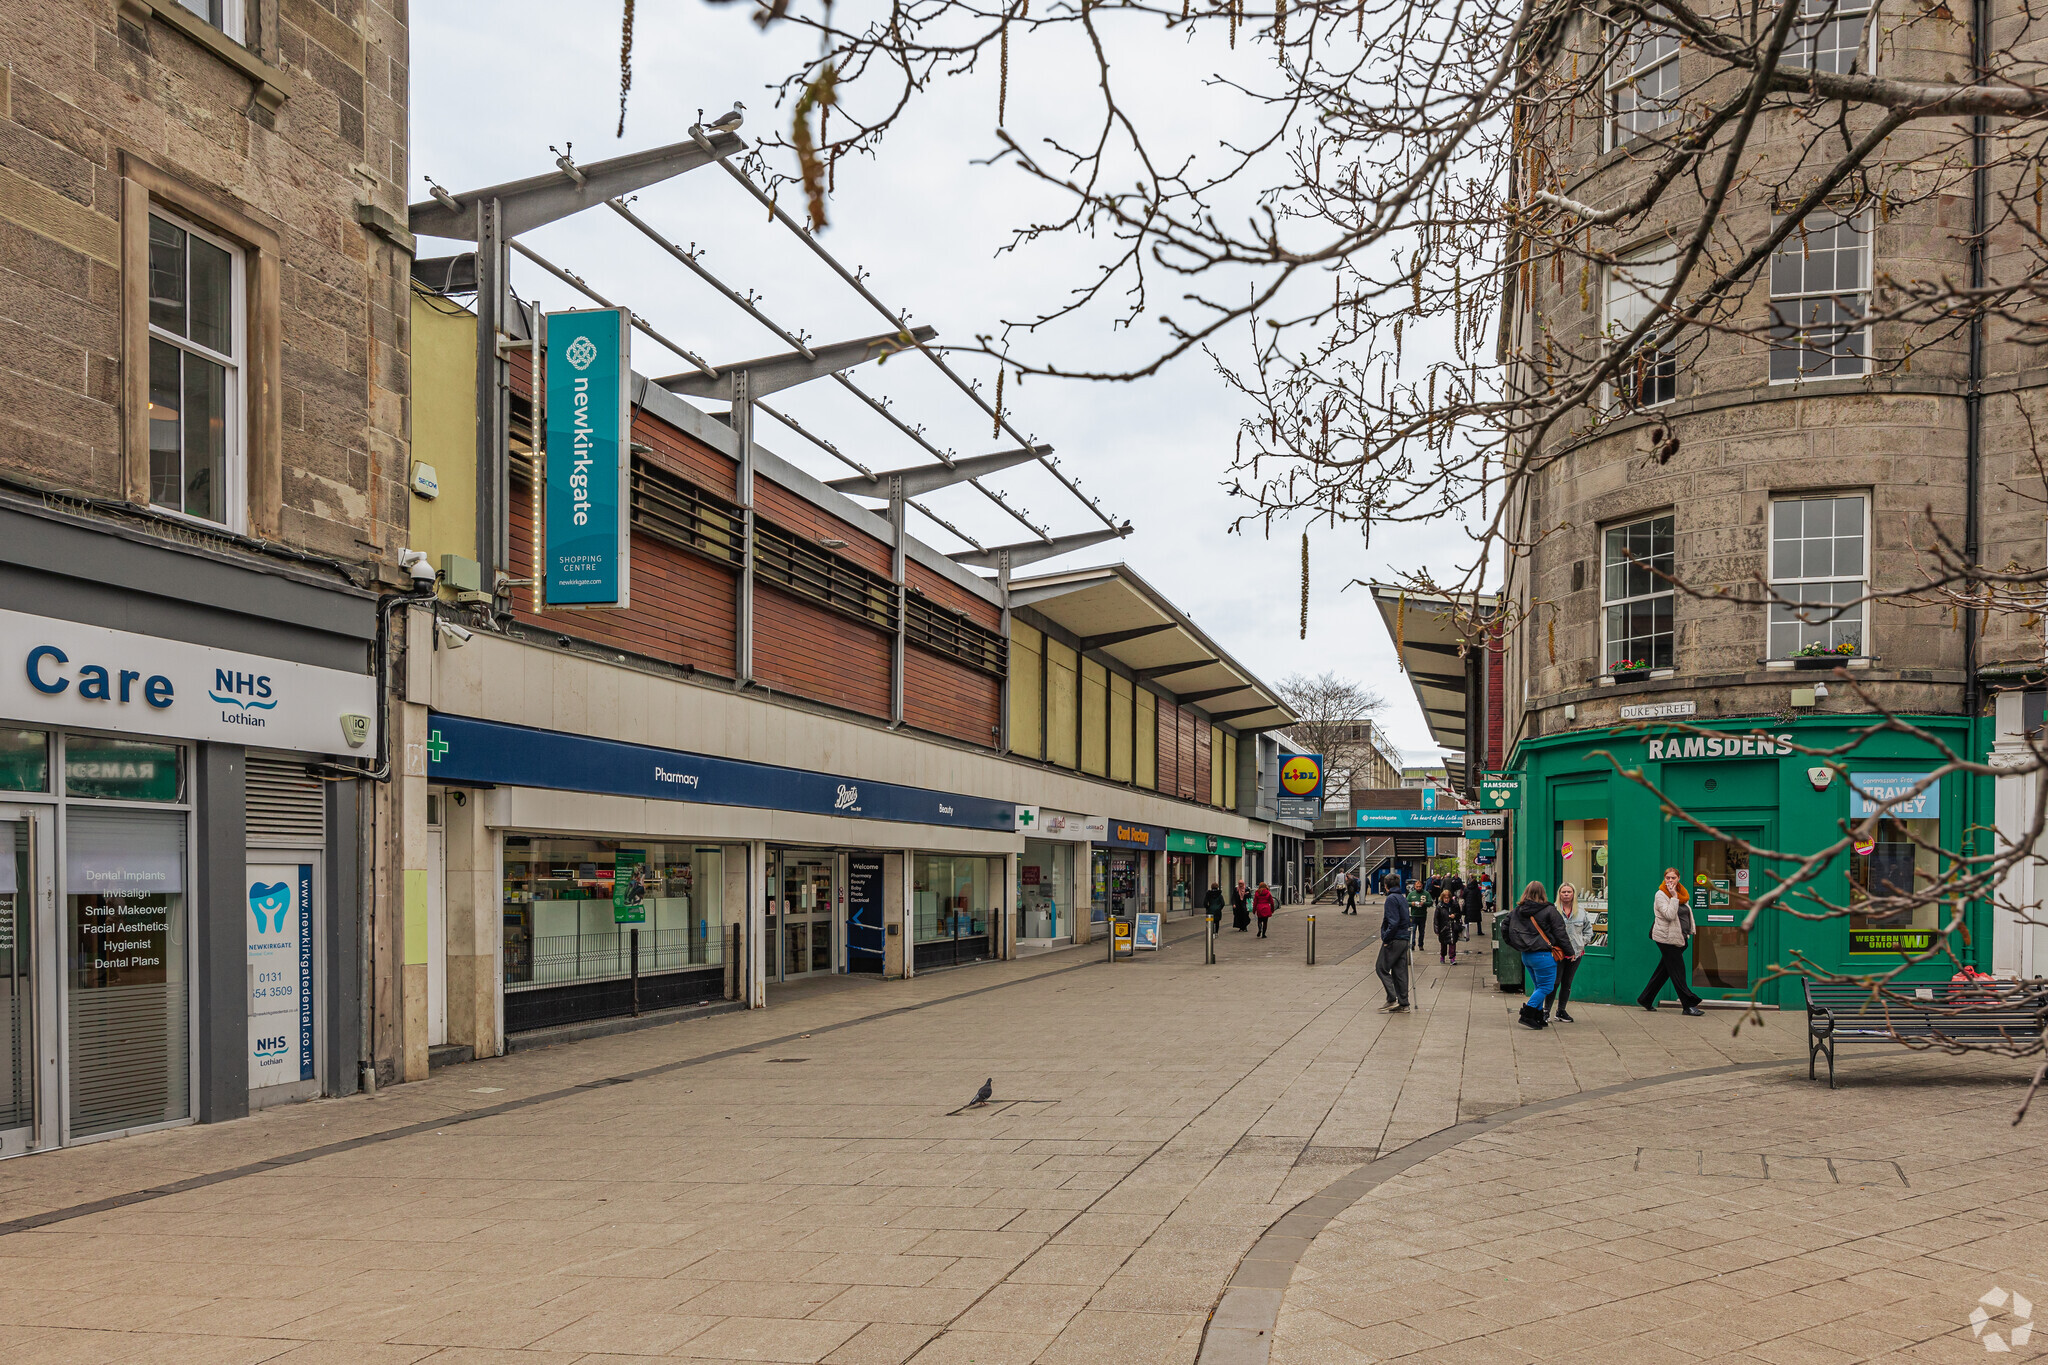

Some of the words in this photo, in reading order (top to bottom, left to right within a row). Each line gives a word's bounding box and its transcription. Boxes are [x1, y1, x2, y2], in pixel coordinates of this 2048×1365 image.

[569, 377, 593, 526] newkirkgate
[559, 554, 602, 564] SHOPPING
[564, 563, 597, 572] CENTRE
[558, 578, 602, 586] newkirkgate.com
[26, 645, 174, 708] Care
[215, 668, 272, 698] NHS
[1623, 707, 1650, 718] DUKE
[1654, 703, 1693, 715] STREET
[221, 710, 266, 728] Lothian
[1649, 734, 1793, 759] RAMSDENS
[655, 766, 699, 789] Pharmacy
[834, 784, 858, 810] Boots
[938, 803, 954, 817] Beauty
[1863, 799, 1927, 813] MNEY
[1432, 814, 1437, 822] of
[1466, 818, 1502, 827] BARBERS
[1117, 825, 1131, 841] Card
[1131, 827, 1149, 847] Factory
[1855, 839, 1873, 849] SALE
[86, 870, 120, 880] Dental
[123, 870, 166, 883] Implants
[103, 888, 151, 900] Invisalign
[85, 906, 115, 916] Smile
[118, 905, 167, 915] Makeover
[83, 924, 115, 934] Facial
[117, 922, 169, 932] Aesthetics
[104, 939, 151, 952] Hygienist
[248, 942, 292, 950] NEWKIRKGATE
[95, 958, 129, 969] Dental
[131, 956, 160, 967] Plans
[259, 972, 282, 983] 0131
[300, 879, 311, 1066] www.newkirkgatedental.co.uk
[269, 985, 293, 997] 3509
[256, 1036, 286, 1050] NHS
[260, 1057, 283, 1067] Lothian
